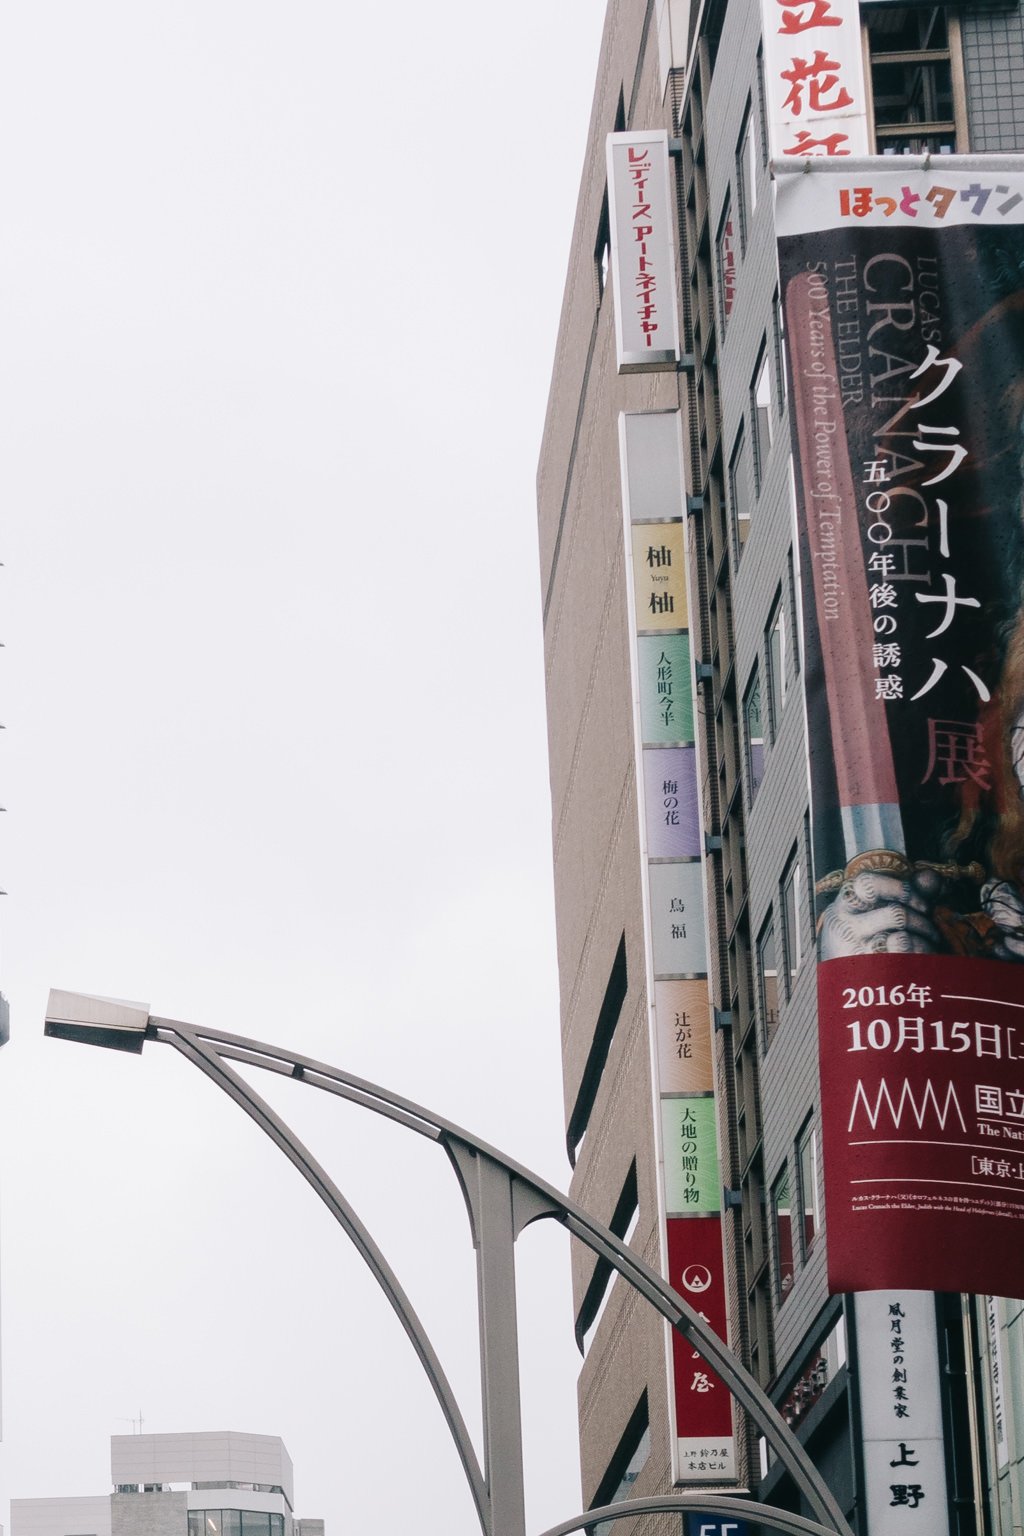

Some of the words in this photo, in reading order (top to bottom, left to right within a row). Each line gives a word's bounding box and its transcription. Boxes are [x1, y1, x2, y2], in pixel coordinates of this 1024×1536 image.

[777, 0, 854, 156] 立花
[628, 147, 652, 219] レディース
[839, 183, 1023, 219] ほっとタウン
[633, 225, 658, 346] アートネイチャー
[807, 261, 830, 300] 500
[835, 254, 858, 314] THE
[917, 256, 942, 342] LUCAS
[809, 306, 831, 356] Years
[804, 361, 835, 382] of
[837, 320, 864, 409] ELDER
[812, 386, 836, 416] the
[863, 253, 931, 585] CRANACH
[813, 418, 837, 479] Power
[810, 481, 842, 509] of
[814, 510, 844, 620] Temptation
[657, 651, 674, 727] 人形町今半
[662, 780, 680, 826] 梅の花
[842, 983, 933, 1008] 2016年
[675, 1011, 692, 1059] 辻が花
[977, 1123, 1000, 1137] The
[680, 1107, 700, 1204] 大地の贈り物
[687, 1461, 727, 1471] 本店ビル
[699, 1448, 729, 1458] 鈴乃屋
